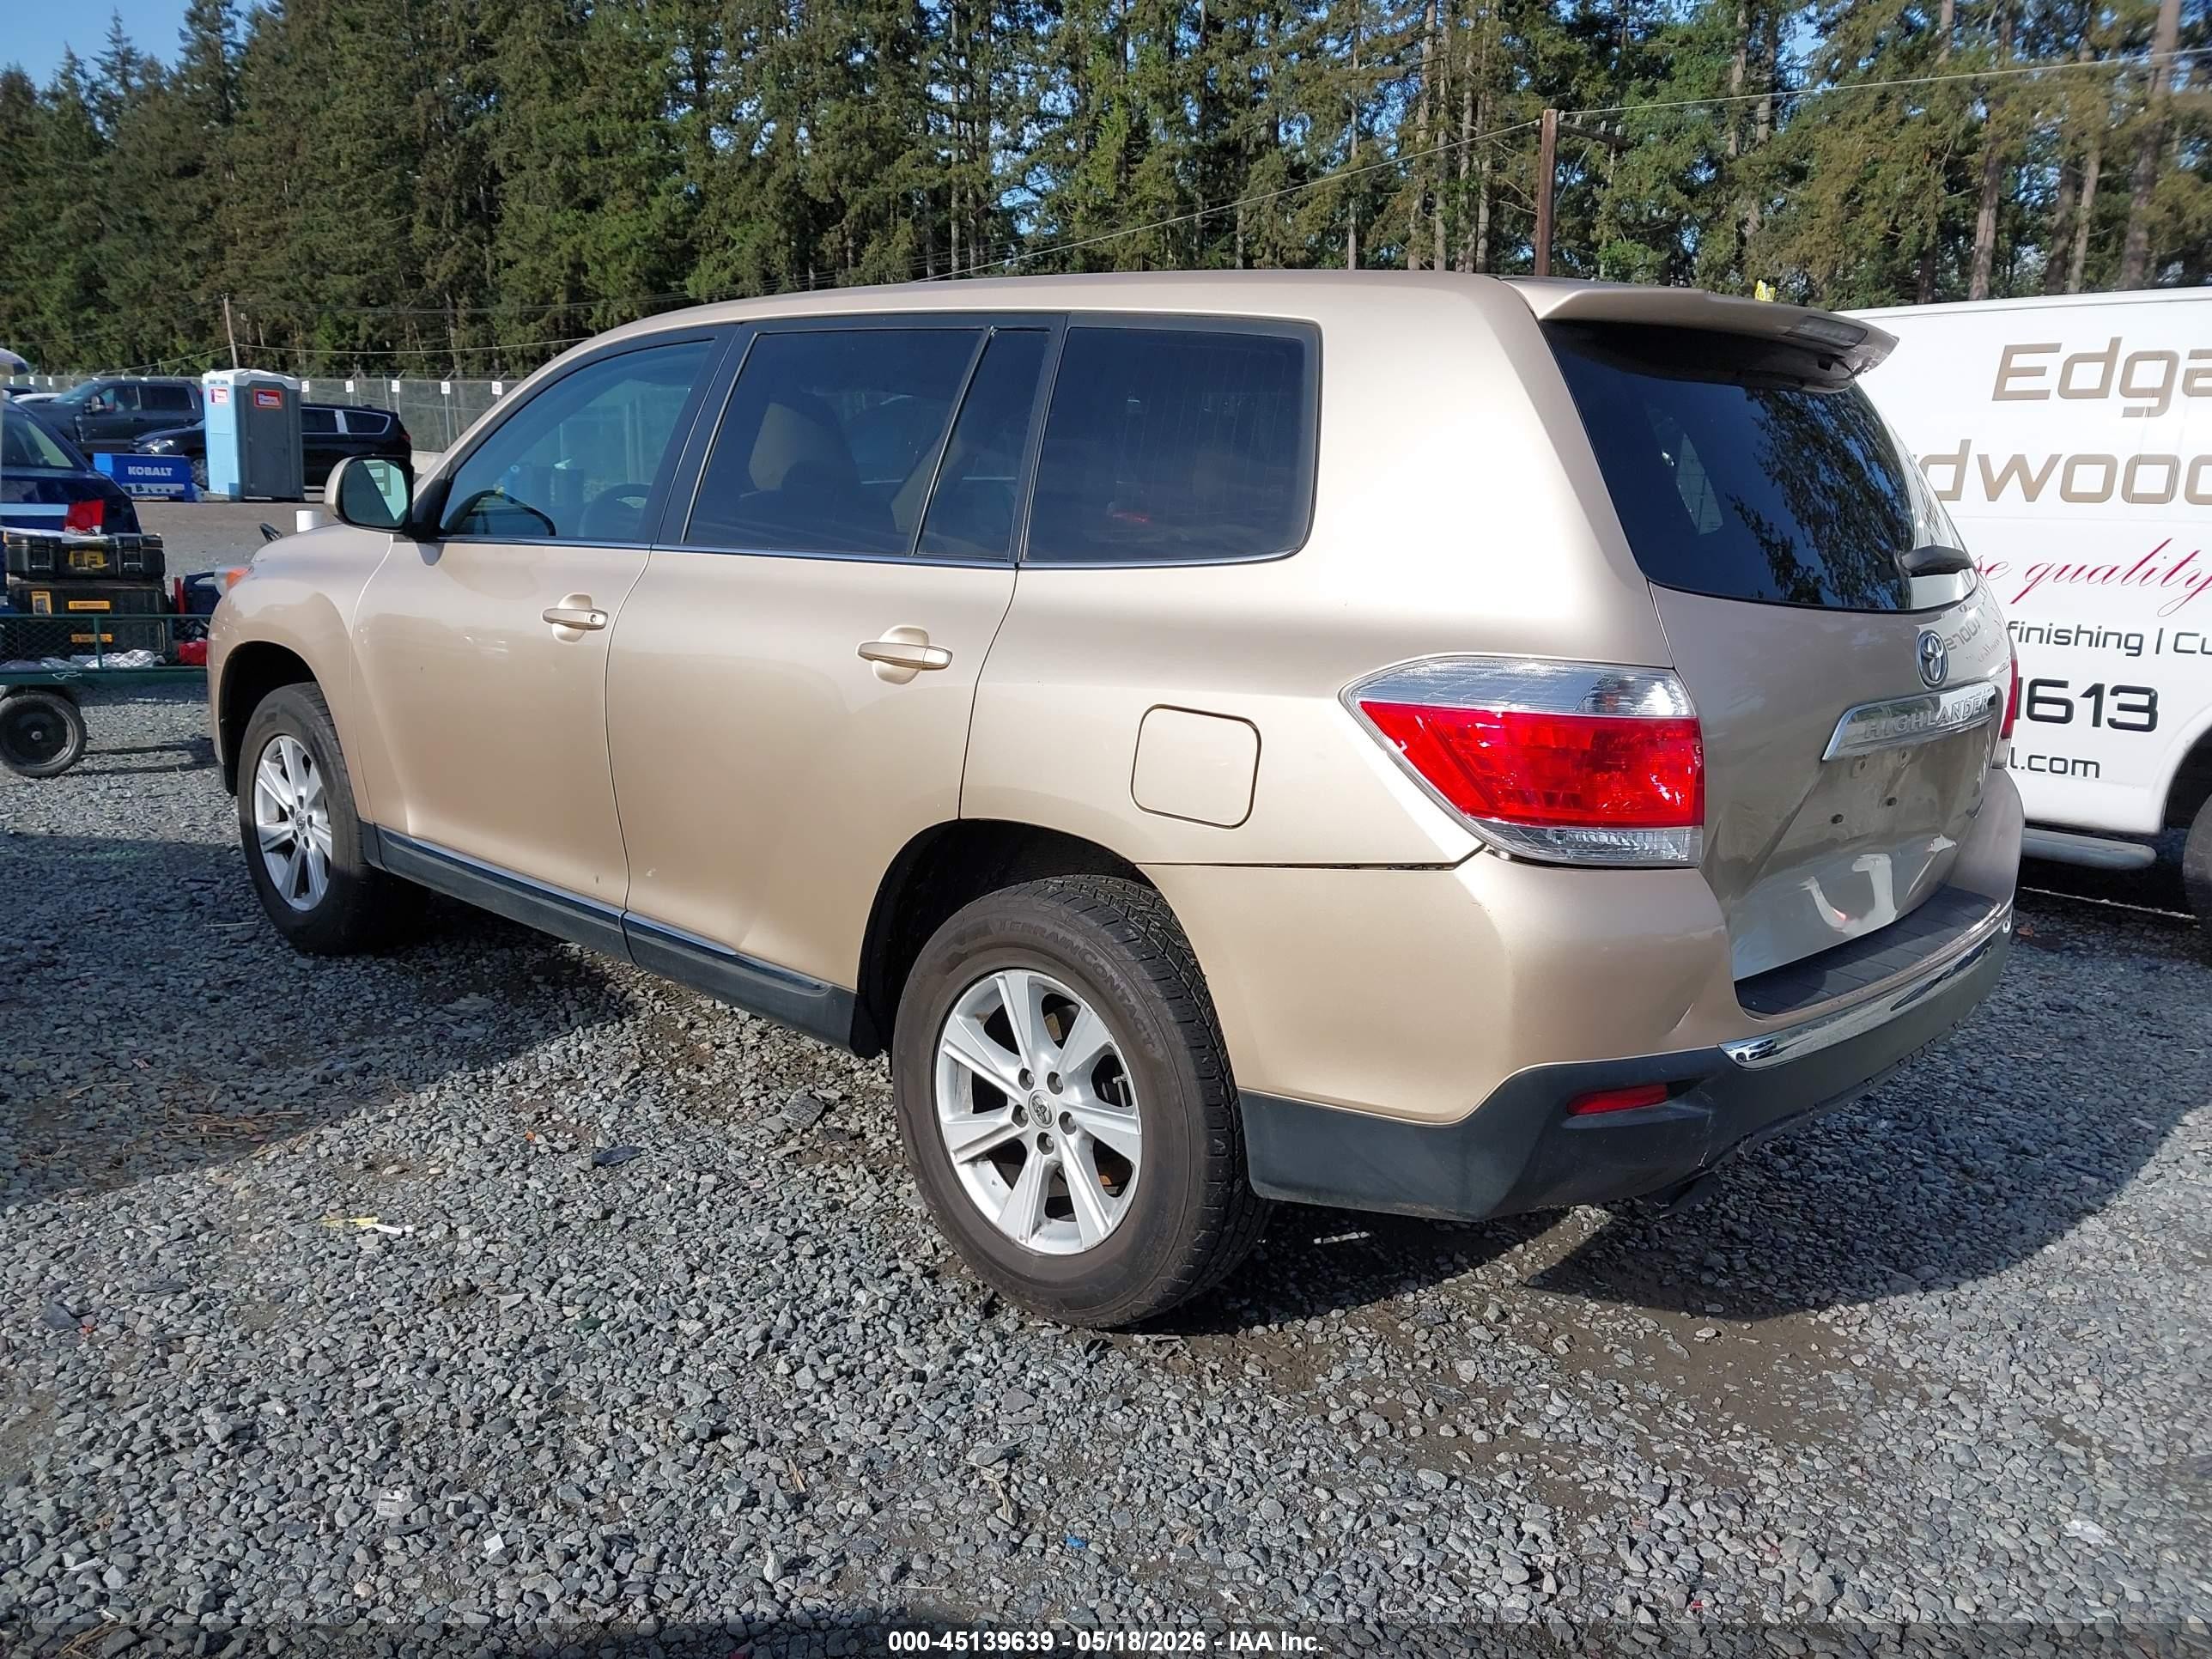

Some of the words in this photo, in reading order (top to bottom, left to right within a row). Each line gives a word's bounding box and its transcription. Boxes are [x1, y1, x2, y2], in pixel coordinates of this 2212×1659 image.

[1992, 337, 2212, 417] Edga
[127, 465, 173, 477] KOBALT
[2010, 538, 2212, 617] quality
[2007, 620, 2144, 658] finishing
[1863, 694, 1990, 739] HIGHLANDER
